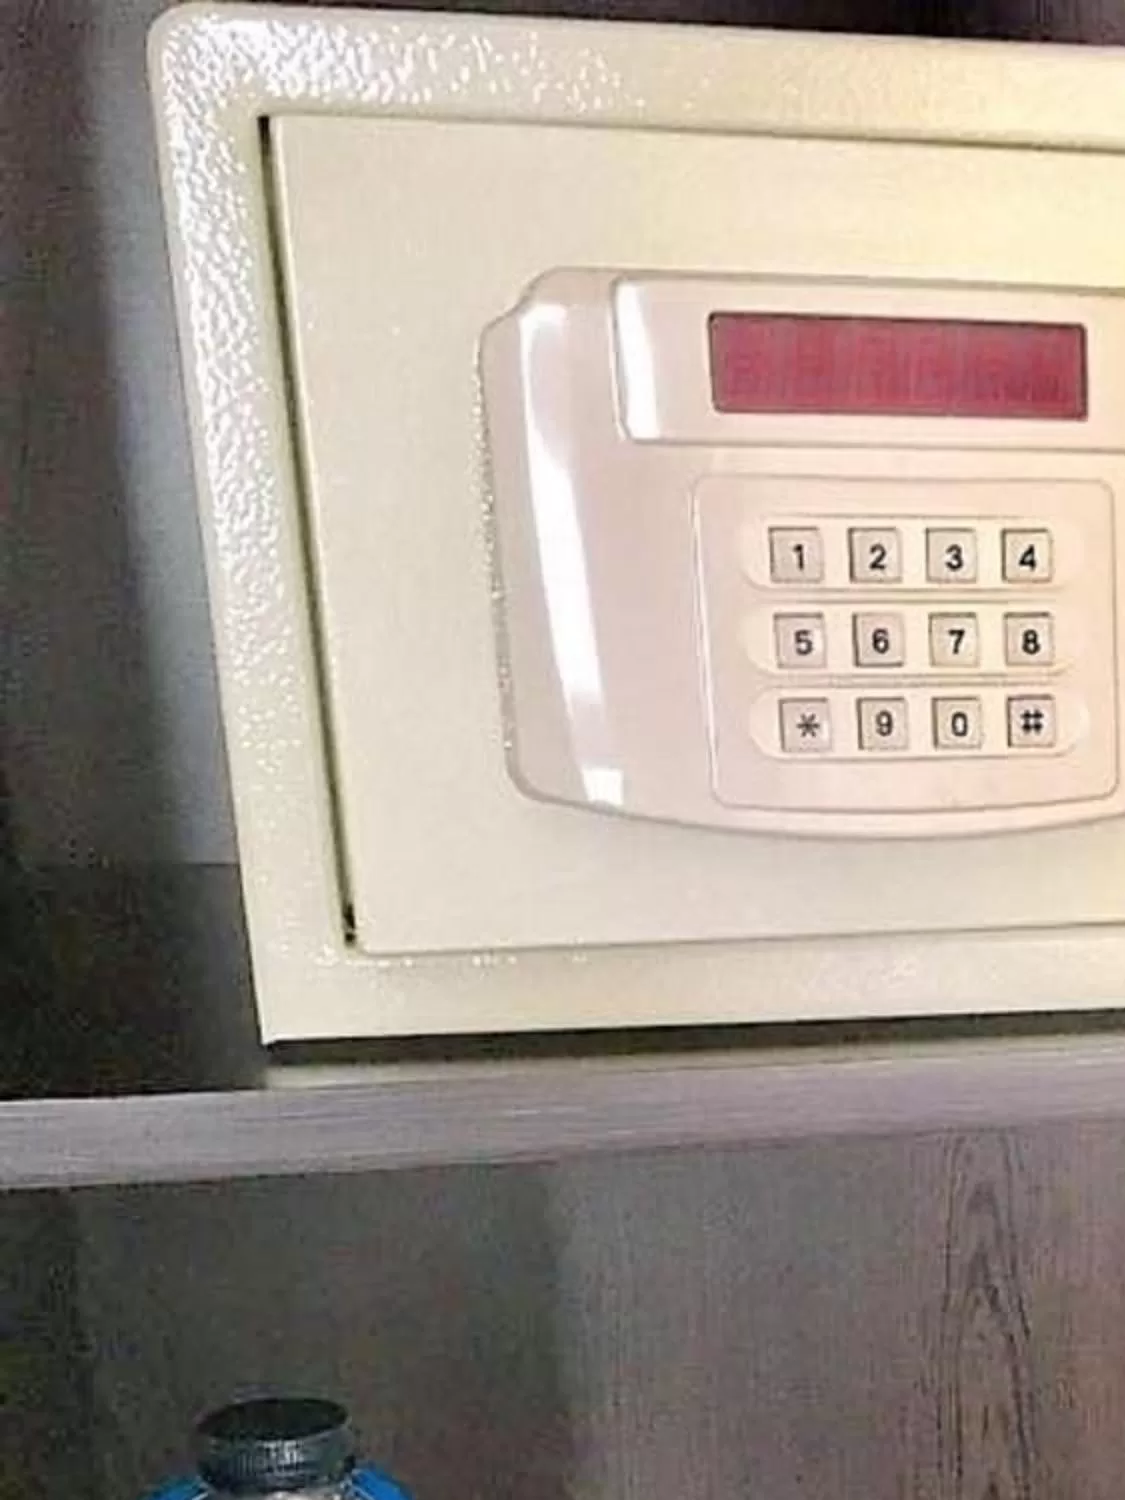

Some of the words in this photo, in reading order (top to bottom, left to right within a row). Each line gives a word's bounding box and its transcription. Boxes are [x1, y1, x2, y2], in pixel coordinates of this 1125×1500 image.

[792, 544, 805, 571] 1
[868, 543, 888, 571] 2
[944, 544, 964, 571] 3
[1018, 544, 1038, 572] 4
[794, 629, 814, 656] 5
[871, 628, 890, 655] 6
[947, 629, 966, 655] 7
[1021, 629, 1041, 656] 8
[874, 710, 894, 737] 9
[950, 711, 969, 737] 0
